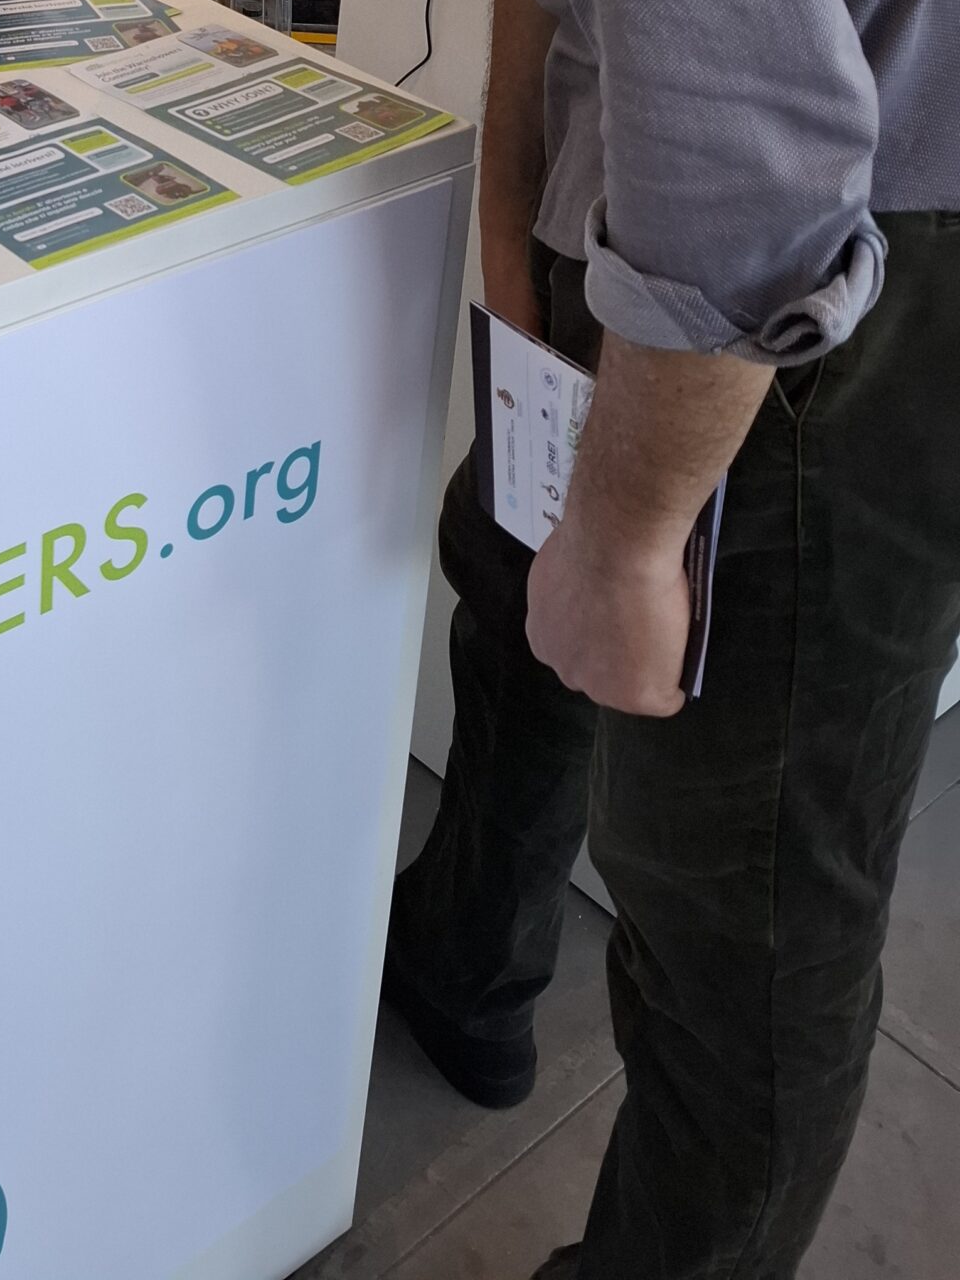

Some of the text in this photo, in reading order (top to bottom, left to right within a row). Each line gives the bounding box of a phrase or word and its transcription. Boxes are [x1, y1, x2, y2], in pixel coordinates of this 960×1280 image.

[208, 85, 275, 111] WHY JOIN?
[546, 440, 557, 464] REI
